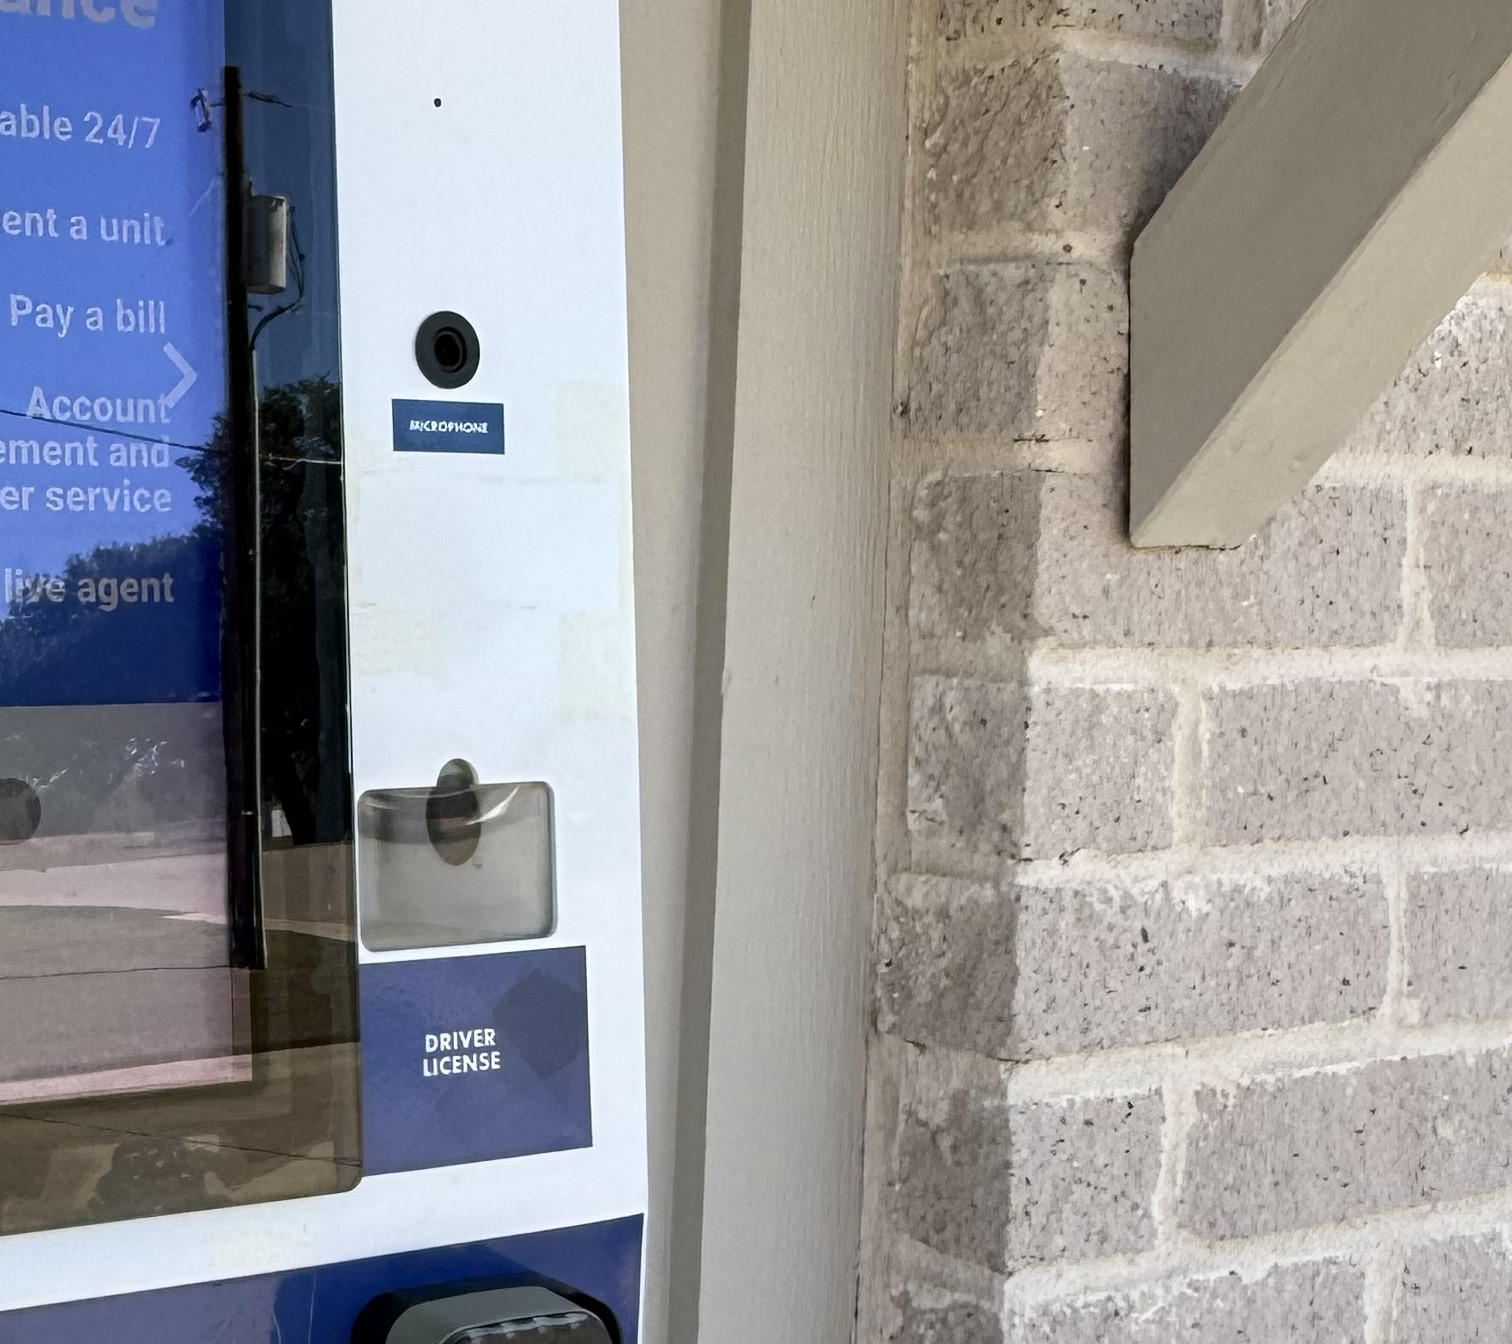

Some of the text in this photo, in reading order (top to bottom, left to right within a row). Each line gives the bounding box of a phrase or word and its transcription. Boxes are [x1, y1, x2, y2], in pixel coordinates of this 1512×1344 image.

[83, 111, 161, 149] 24/7
[69, 215, 88, 240] a
[99, 212, 167, 246] unit
[9, 293, 166, 338] Pay a bill
[25, 385, 172, 424] Account
[409, 419, 489, 434] MICROPHONE
[109, 434, 170, 469] and
[45, 479, 173, 513] service
[4, 567, 66, 604] live
[76, 572, 175, 612] agent
[424, 1027, 497, 1054] DRIVER
[422, 1050, 502, 1078] LICENSE
